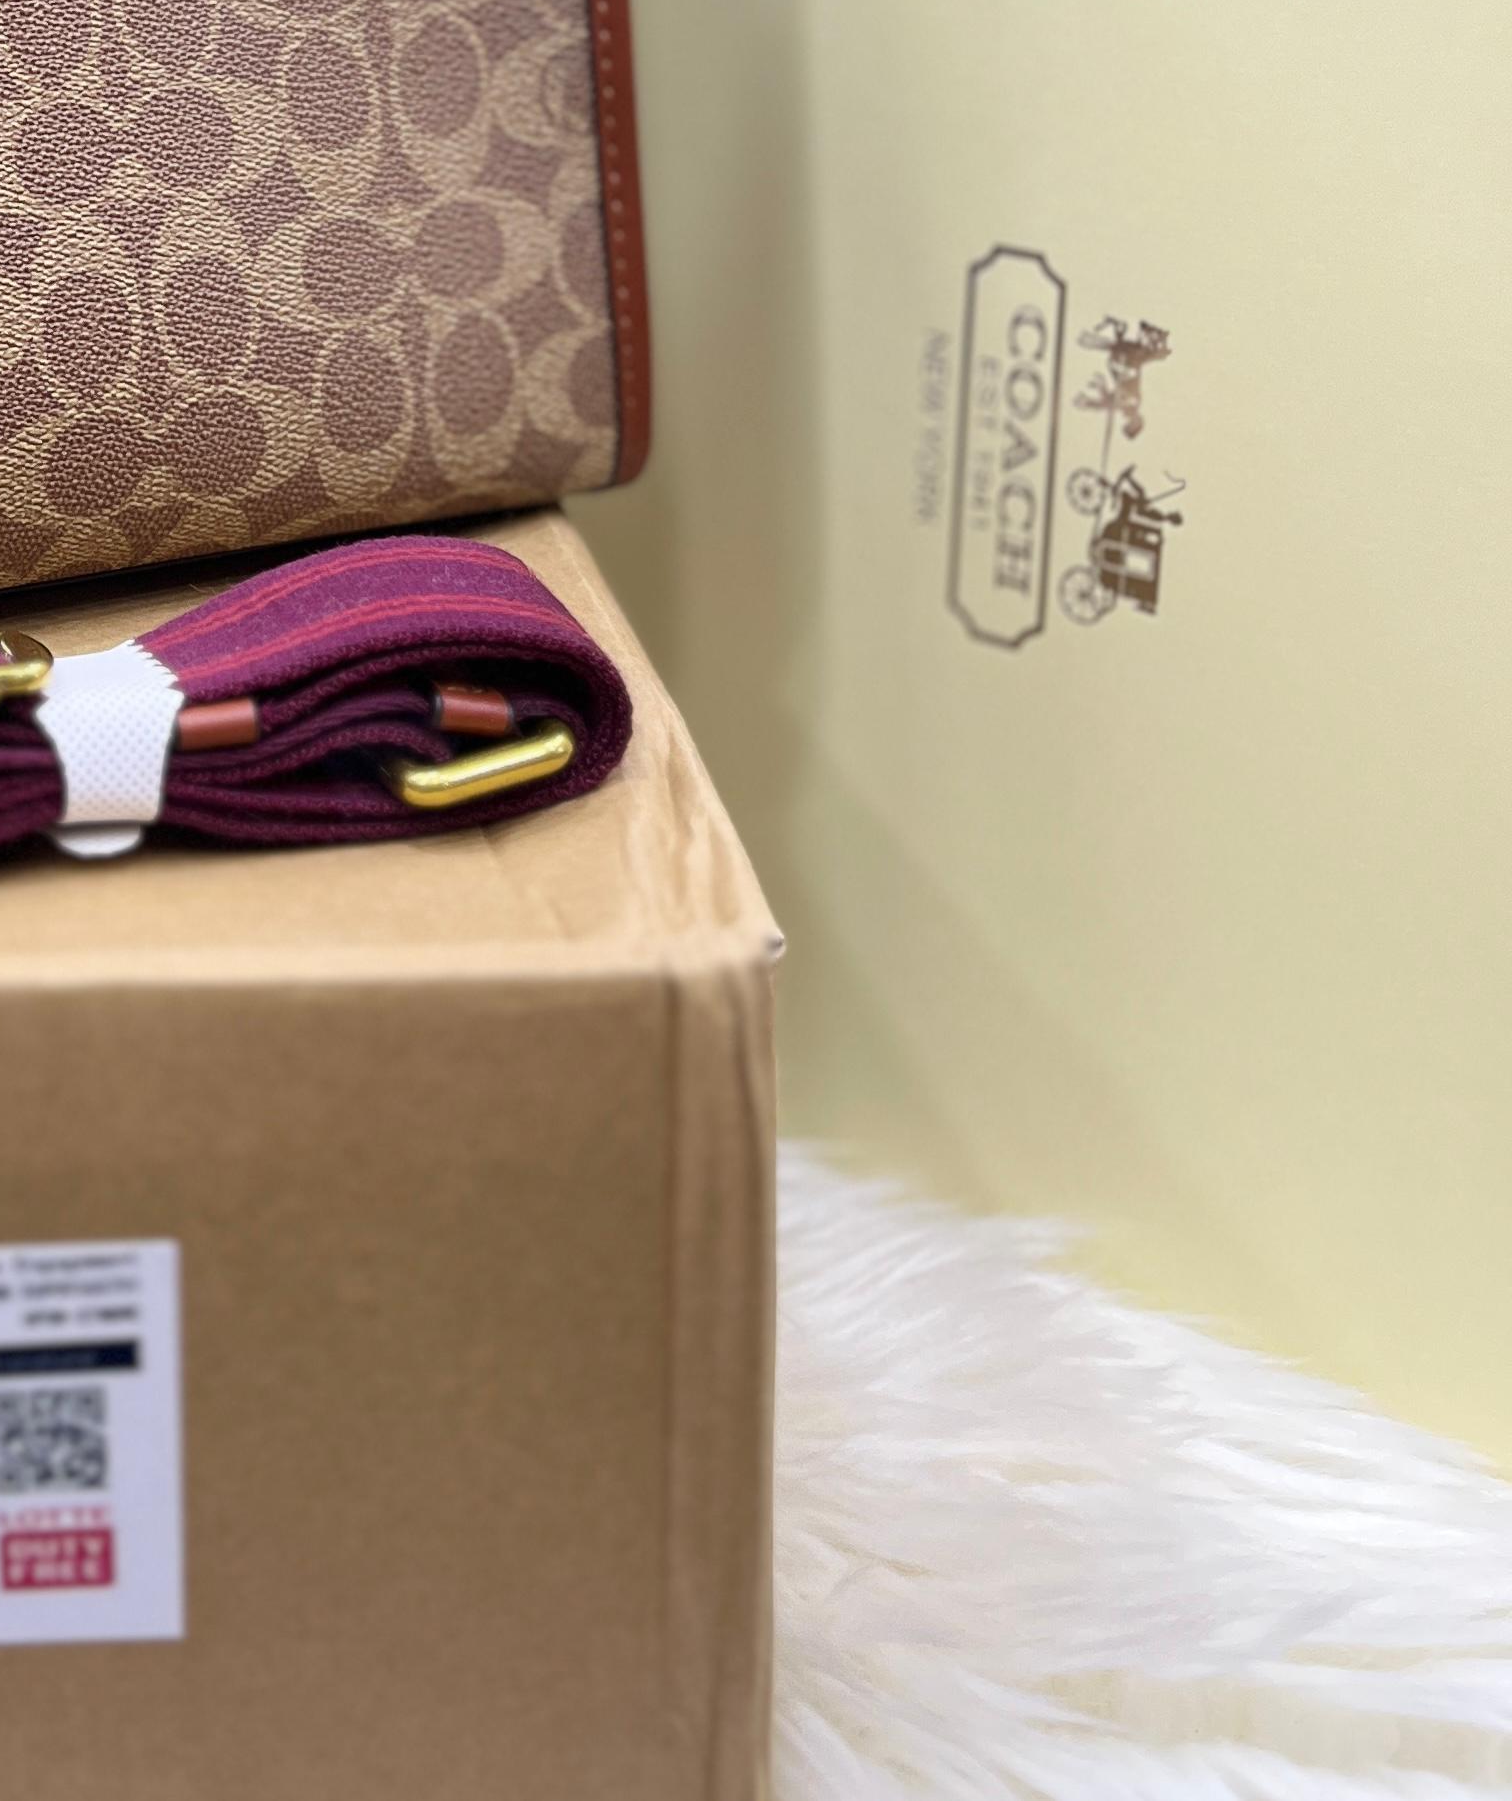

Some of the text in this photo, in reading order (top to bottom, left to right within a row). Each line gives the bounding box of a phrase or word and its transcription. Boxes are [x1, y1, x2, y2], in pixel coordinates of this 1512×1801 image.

[993, 304, 1048, 596] COACH
[6, 1534, 107, 1560] DUTY
[7, 1558, 102, 1583] FREE
